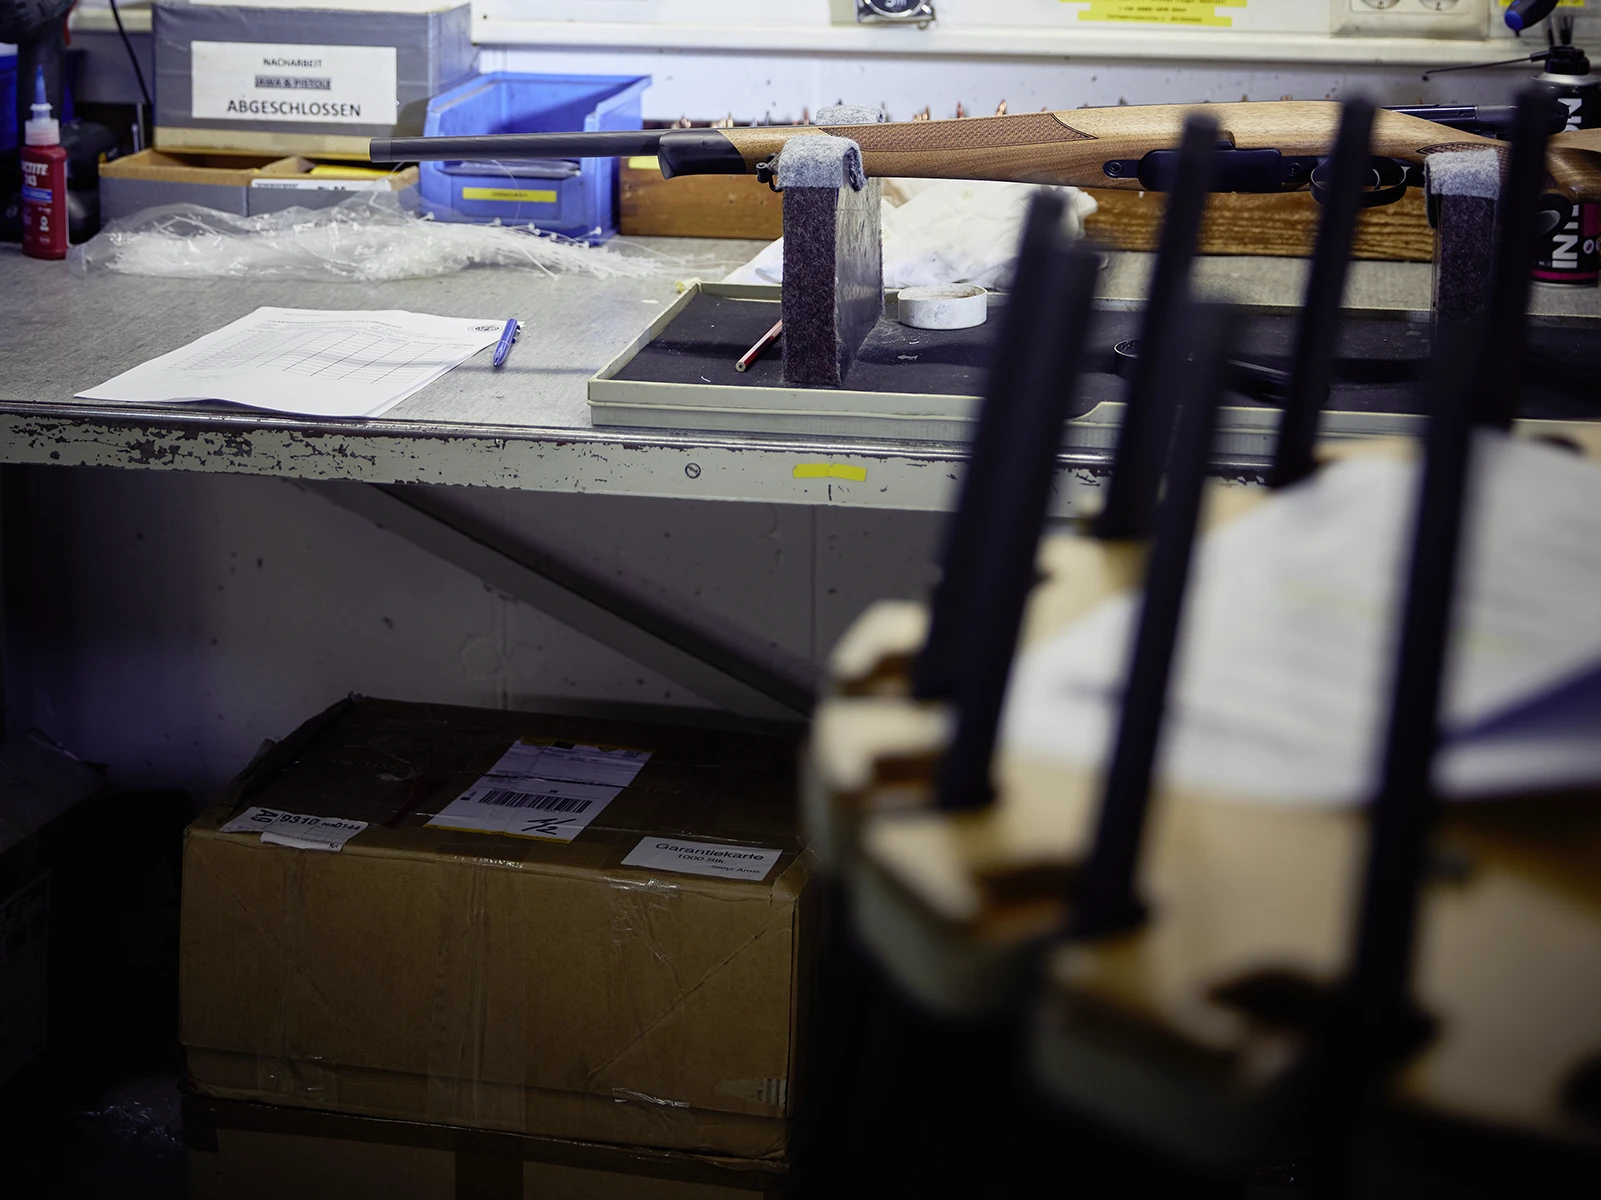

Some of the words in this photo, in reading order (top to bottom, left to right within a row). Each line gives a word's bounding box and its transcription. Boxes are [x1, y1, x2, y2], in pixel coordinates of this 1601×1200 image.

[227, 100, 361, 117] ABGESCHLOSSEN
[279, 814, 321, 826] 9310
[656, 842, 764, 861] Garantiekarte
[677, 853, 704, 862] 1000
